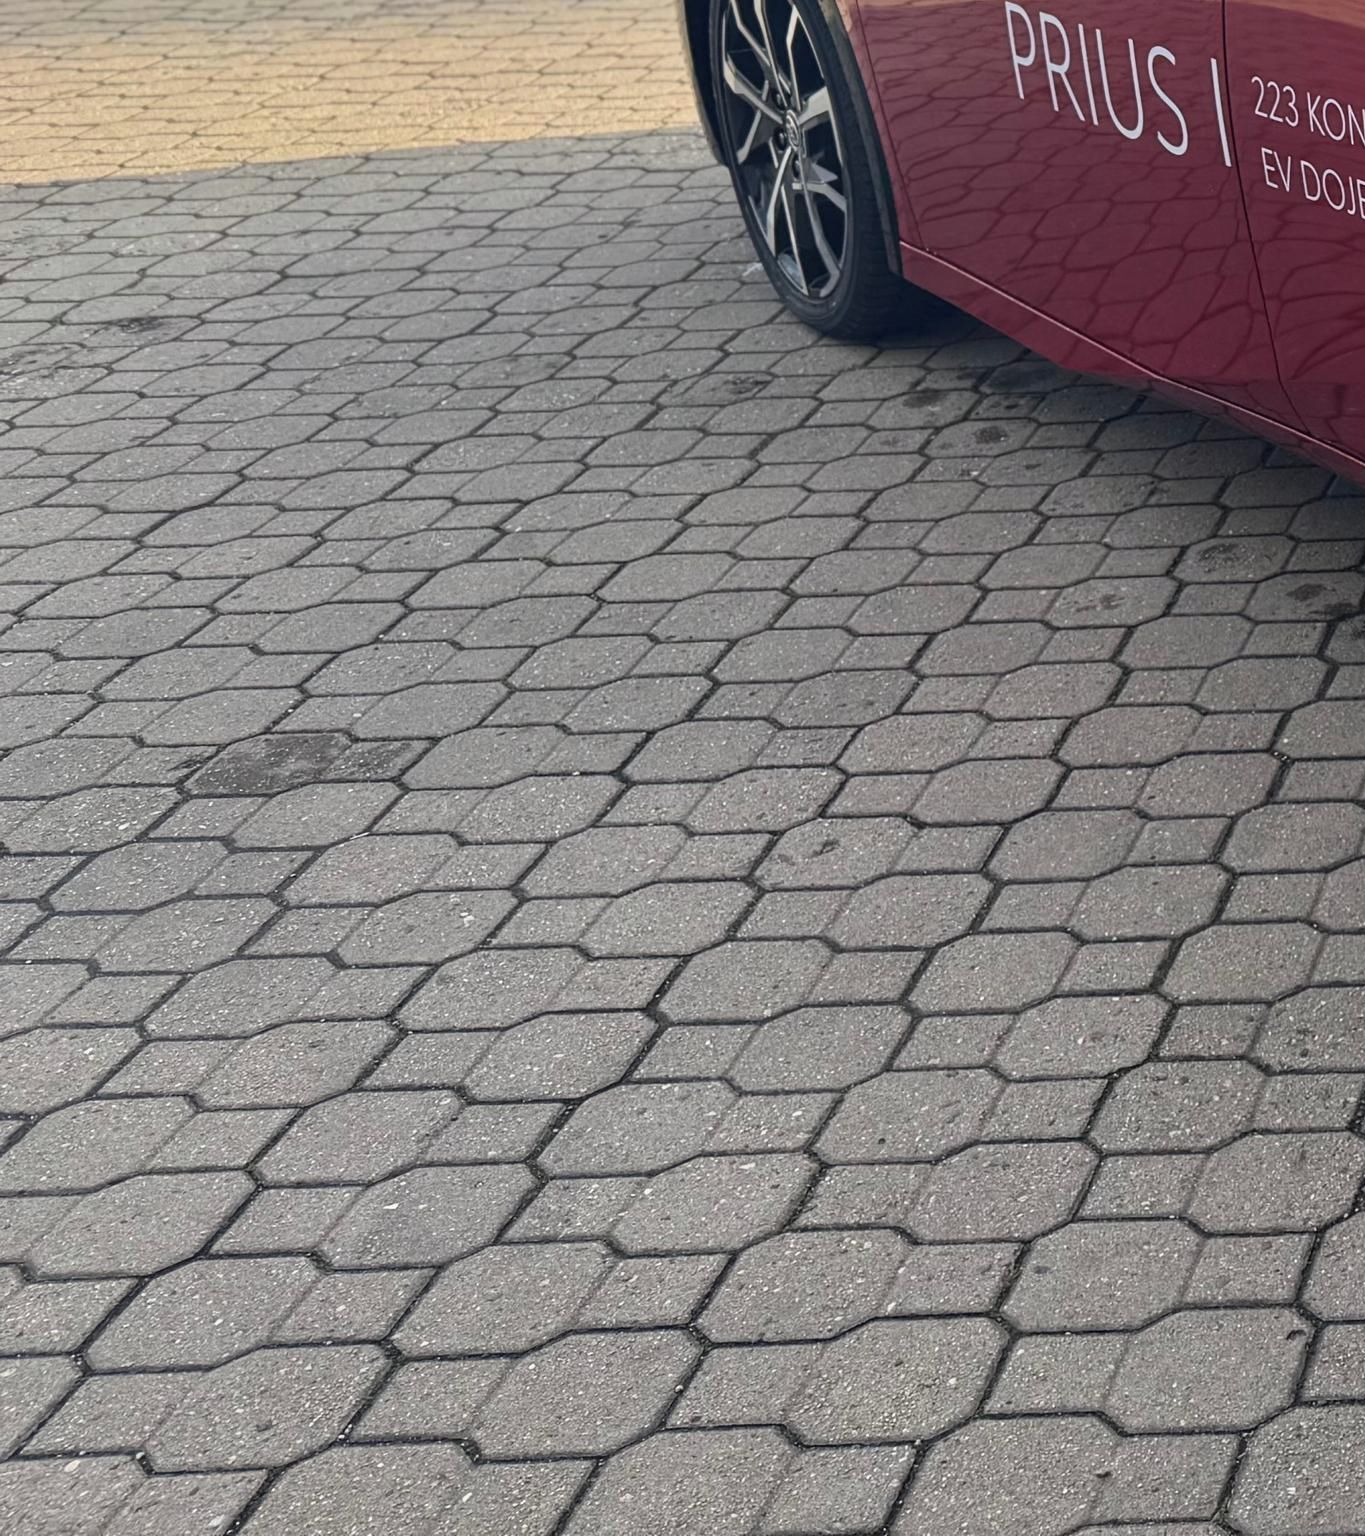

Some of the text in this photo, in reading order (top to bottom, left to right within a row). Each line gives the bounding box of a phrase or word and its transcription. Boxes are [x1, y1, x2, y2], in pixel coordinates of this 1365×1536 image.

[1005, 0, 1189, 156] PRIUS
[1251, 75, 1299, 127] 223
[1261, 147, 1291, 193] EV
